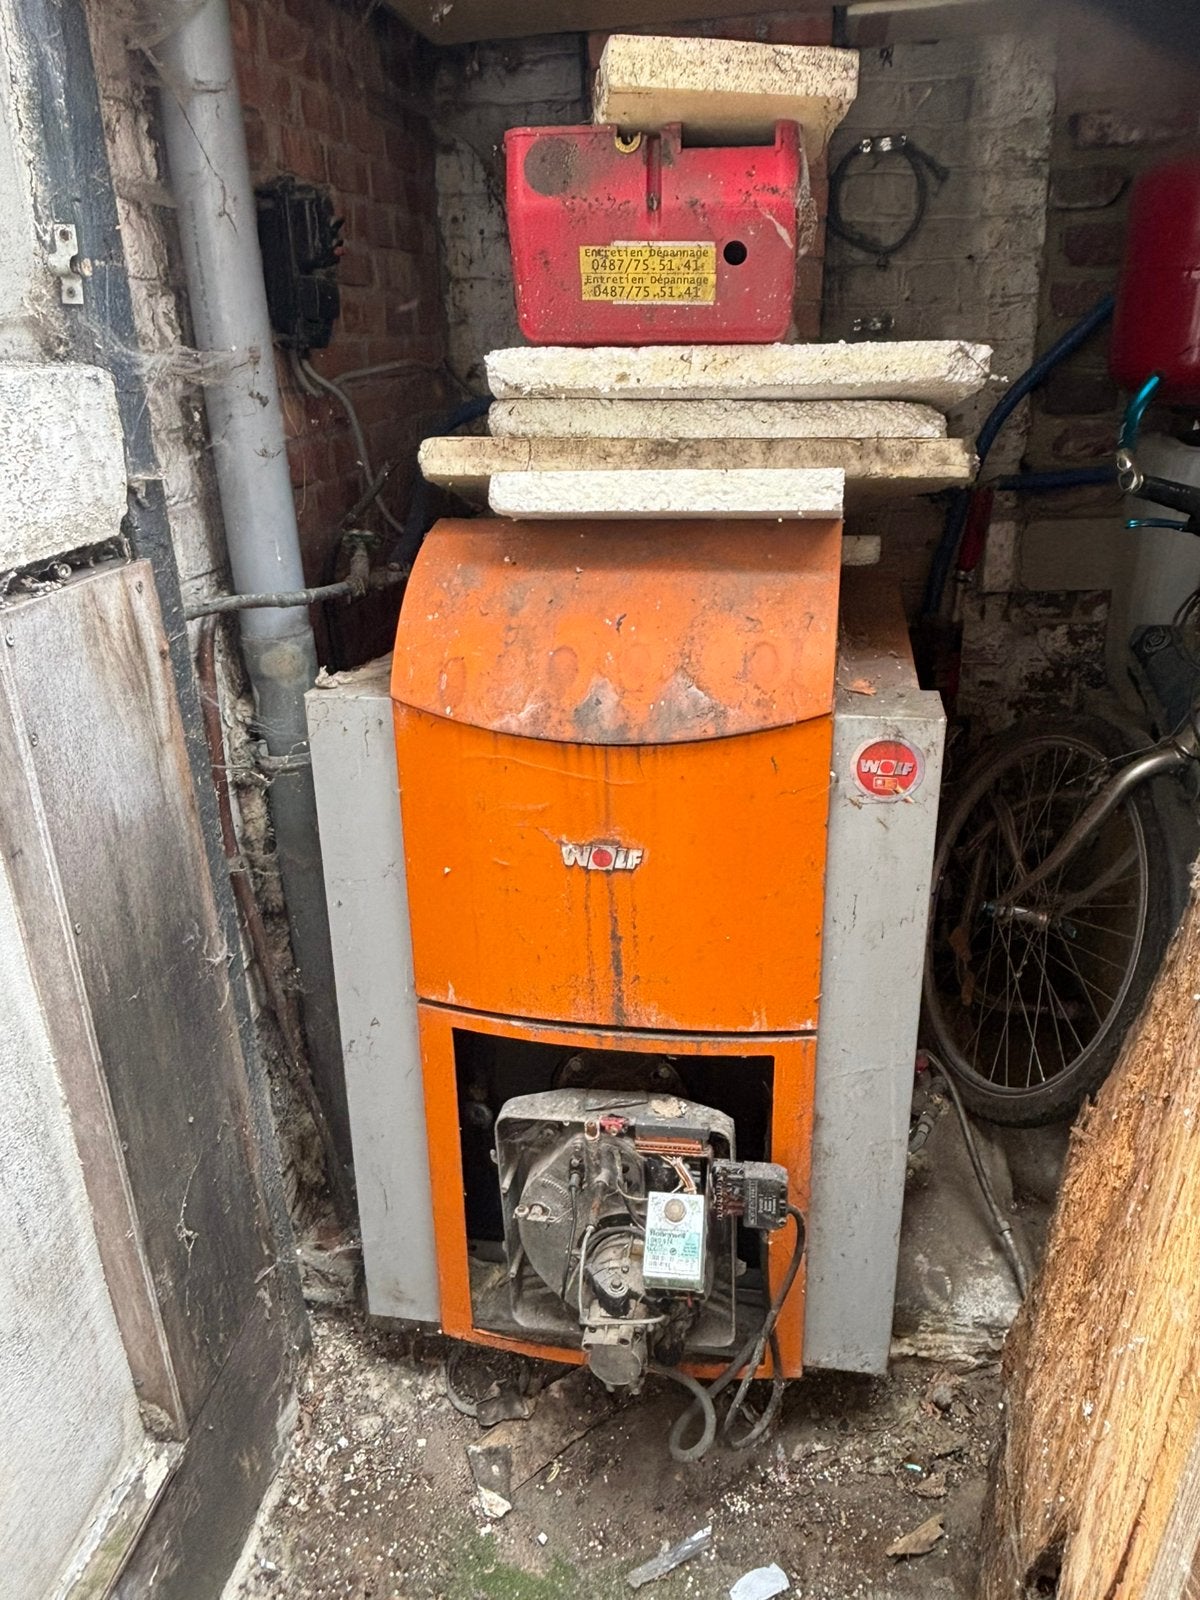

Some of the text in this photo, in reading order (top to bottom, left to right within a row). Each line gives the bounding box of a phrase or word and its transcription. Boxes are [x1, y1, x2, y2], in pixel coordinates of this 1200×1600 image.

[584, 246, 709, 259] Entretien Dépannage
[591, 259, 701, 273] 0487/75.51.41
[586, 274, 709, 287] Entretien Dépannage
[593, 286, 701, 299] 0487/75.51.41
[860, 759, 915, 775] WOLF
[561, 844, 644, 871] WOLF
